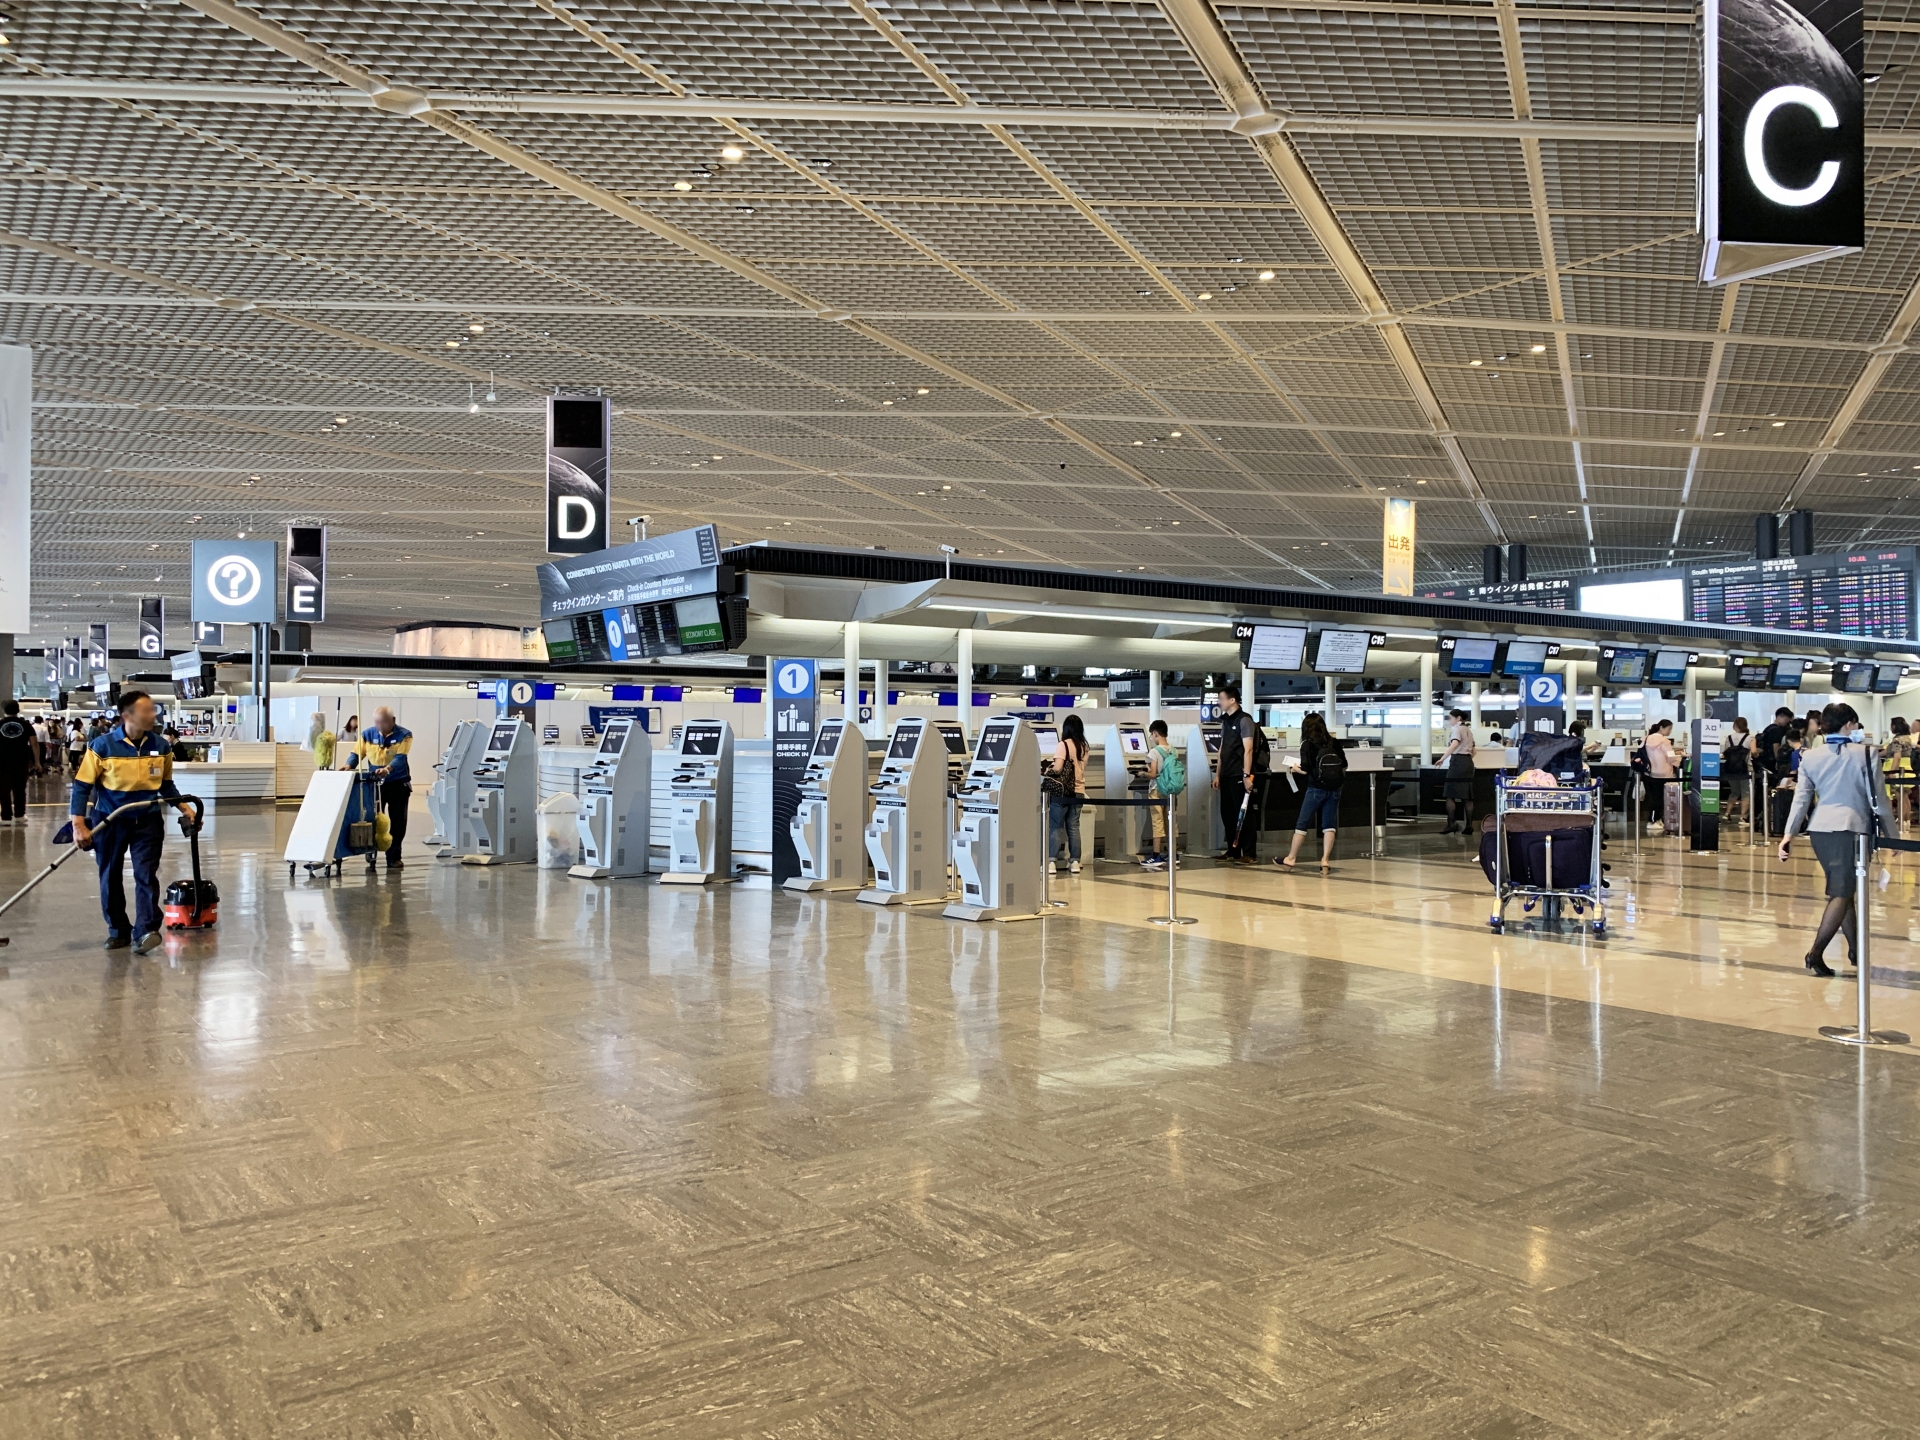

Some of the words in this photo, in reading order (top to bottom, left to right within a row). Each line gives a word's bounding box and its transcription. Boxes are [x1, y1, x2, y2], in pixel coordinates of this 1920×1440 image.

[1744, 85, 1840, 207] C
[557, 495, 596, 540] D
[1388, 534, 1410, 551] 出発
[566, 566, 596, 580] CONNECTING
[596, 563, 612, 574] TOKYO
[612, 559, 630, 572] NARITA
[630, 556, 644, 568] WITH
[644, 554, 655, 564] THE
[655, 550, 675, 562] WORLD
[1708, 567, 1724, 575] Wing
[1724, 565, 1757, 573] Departures
[627, 581, 644, 593] Check-in
[644, 578, 661, 590] Counters
[661, 575, 685, 586] Information
[1478, 580, 1570, 595] 南ウイング出発便ご案内
[293, 586, 316, 613] E
[552, 592, 606, 612] チェックインカウンター
[607, 588, 625, 602] ご案内
[611, 625, 617, 643] 1
[685, 630, 703, 639] ECONOMY
[703, 628, 717, 637] CLASS
[1236, 626, 1252, 637] C14
[141, 634, 160, 653] G
[1371, 635, 1385, 646] C15
[1441, 639, 1455, 650] C16
[1548, 645, 1560, 655] C17
[89, 652, 105, 668] H
[47, 669, 57, 682] J
[787, 669, 797, 688] 1
[517, 686, 524, 700] 1
[1538, 681, 1551, 698] 2
